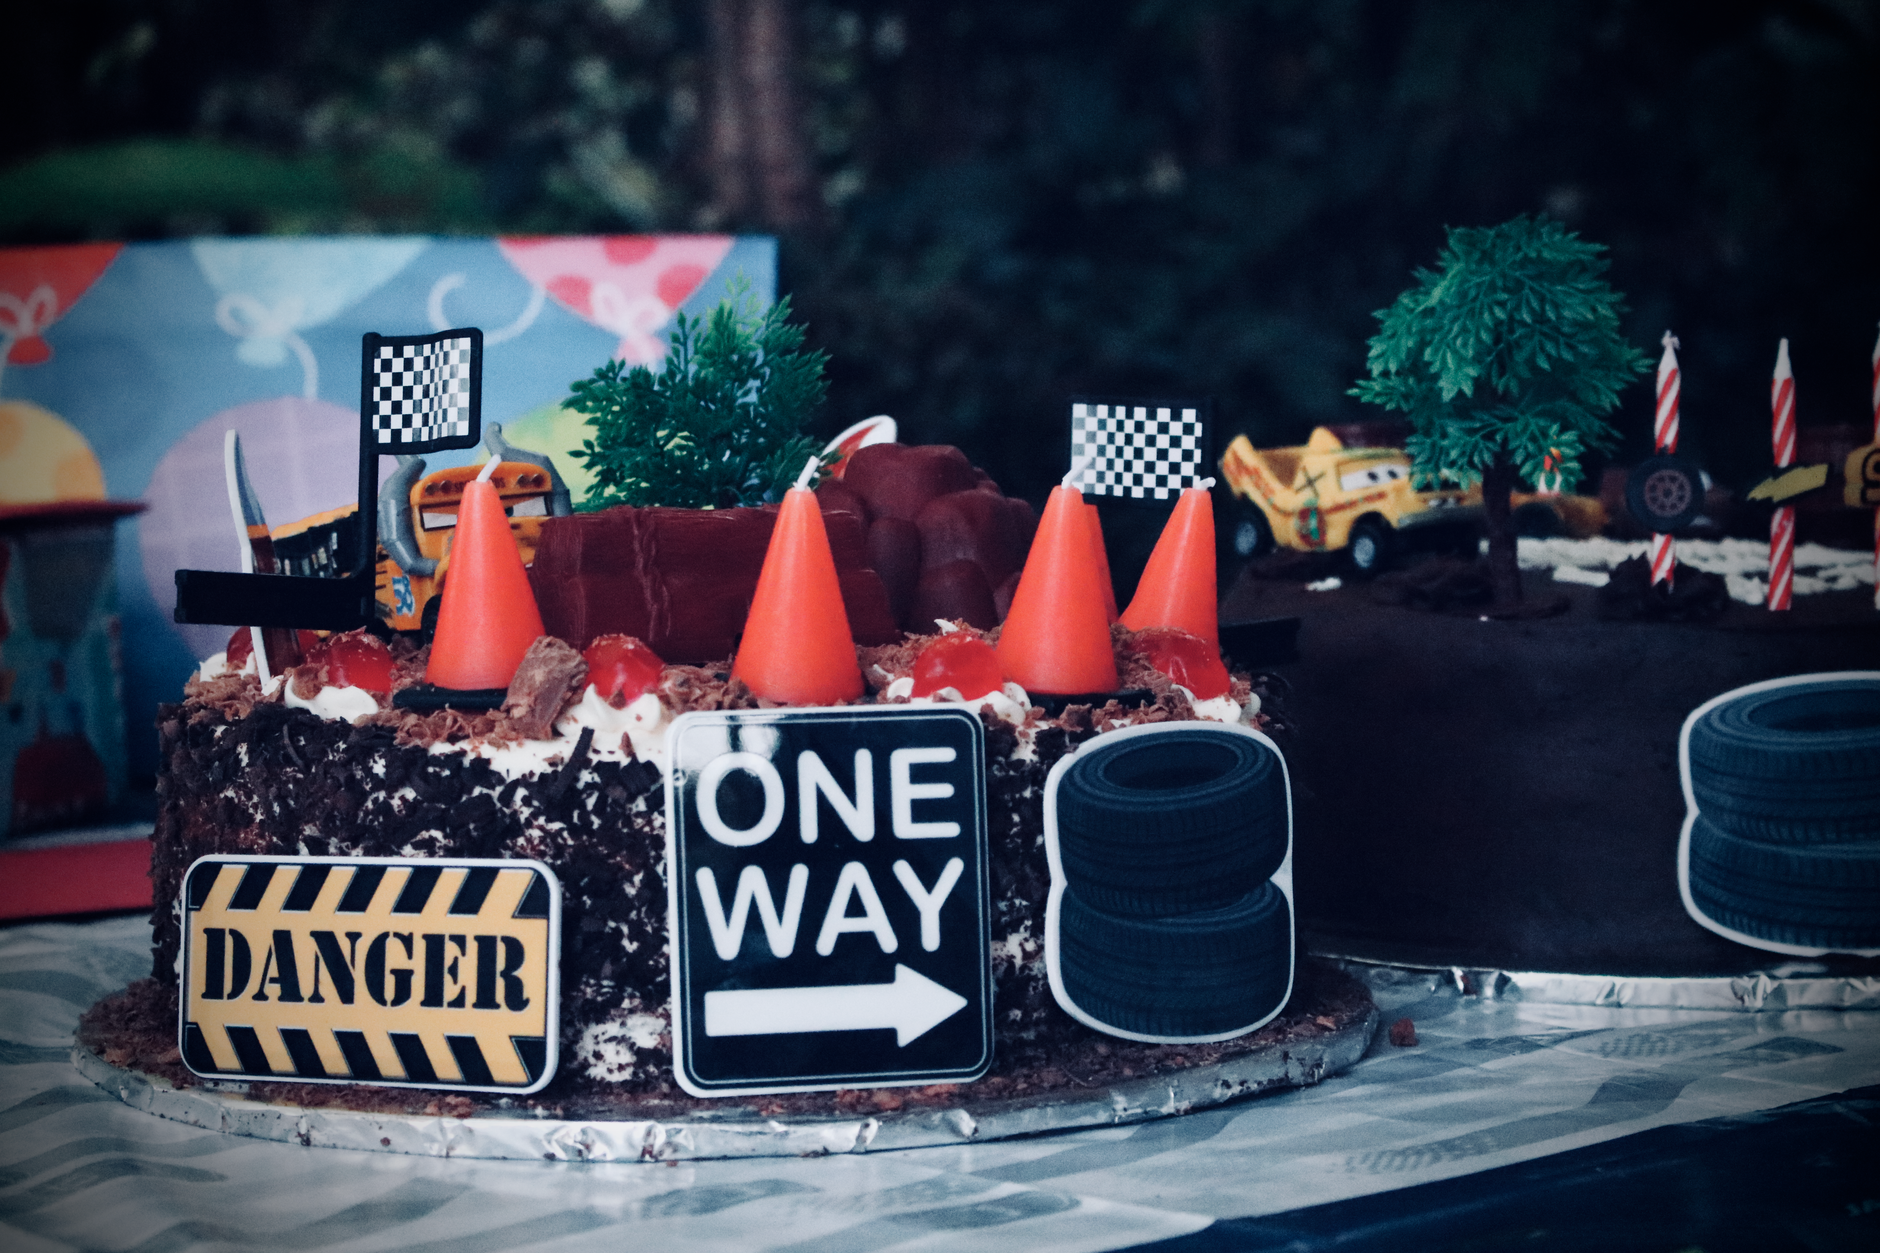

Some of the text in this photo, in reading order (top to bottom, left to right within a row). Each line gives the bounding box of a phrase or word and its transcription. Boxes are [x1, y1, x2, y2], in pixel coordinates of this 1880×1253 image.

[695, 747, 961, 848] ONE
[696, 857, 965, 961] WAY
[200, 927, 531, 1012] DANGER
